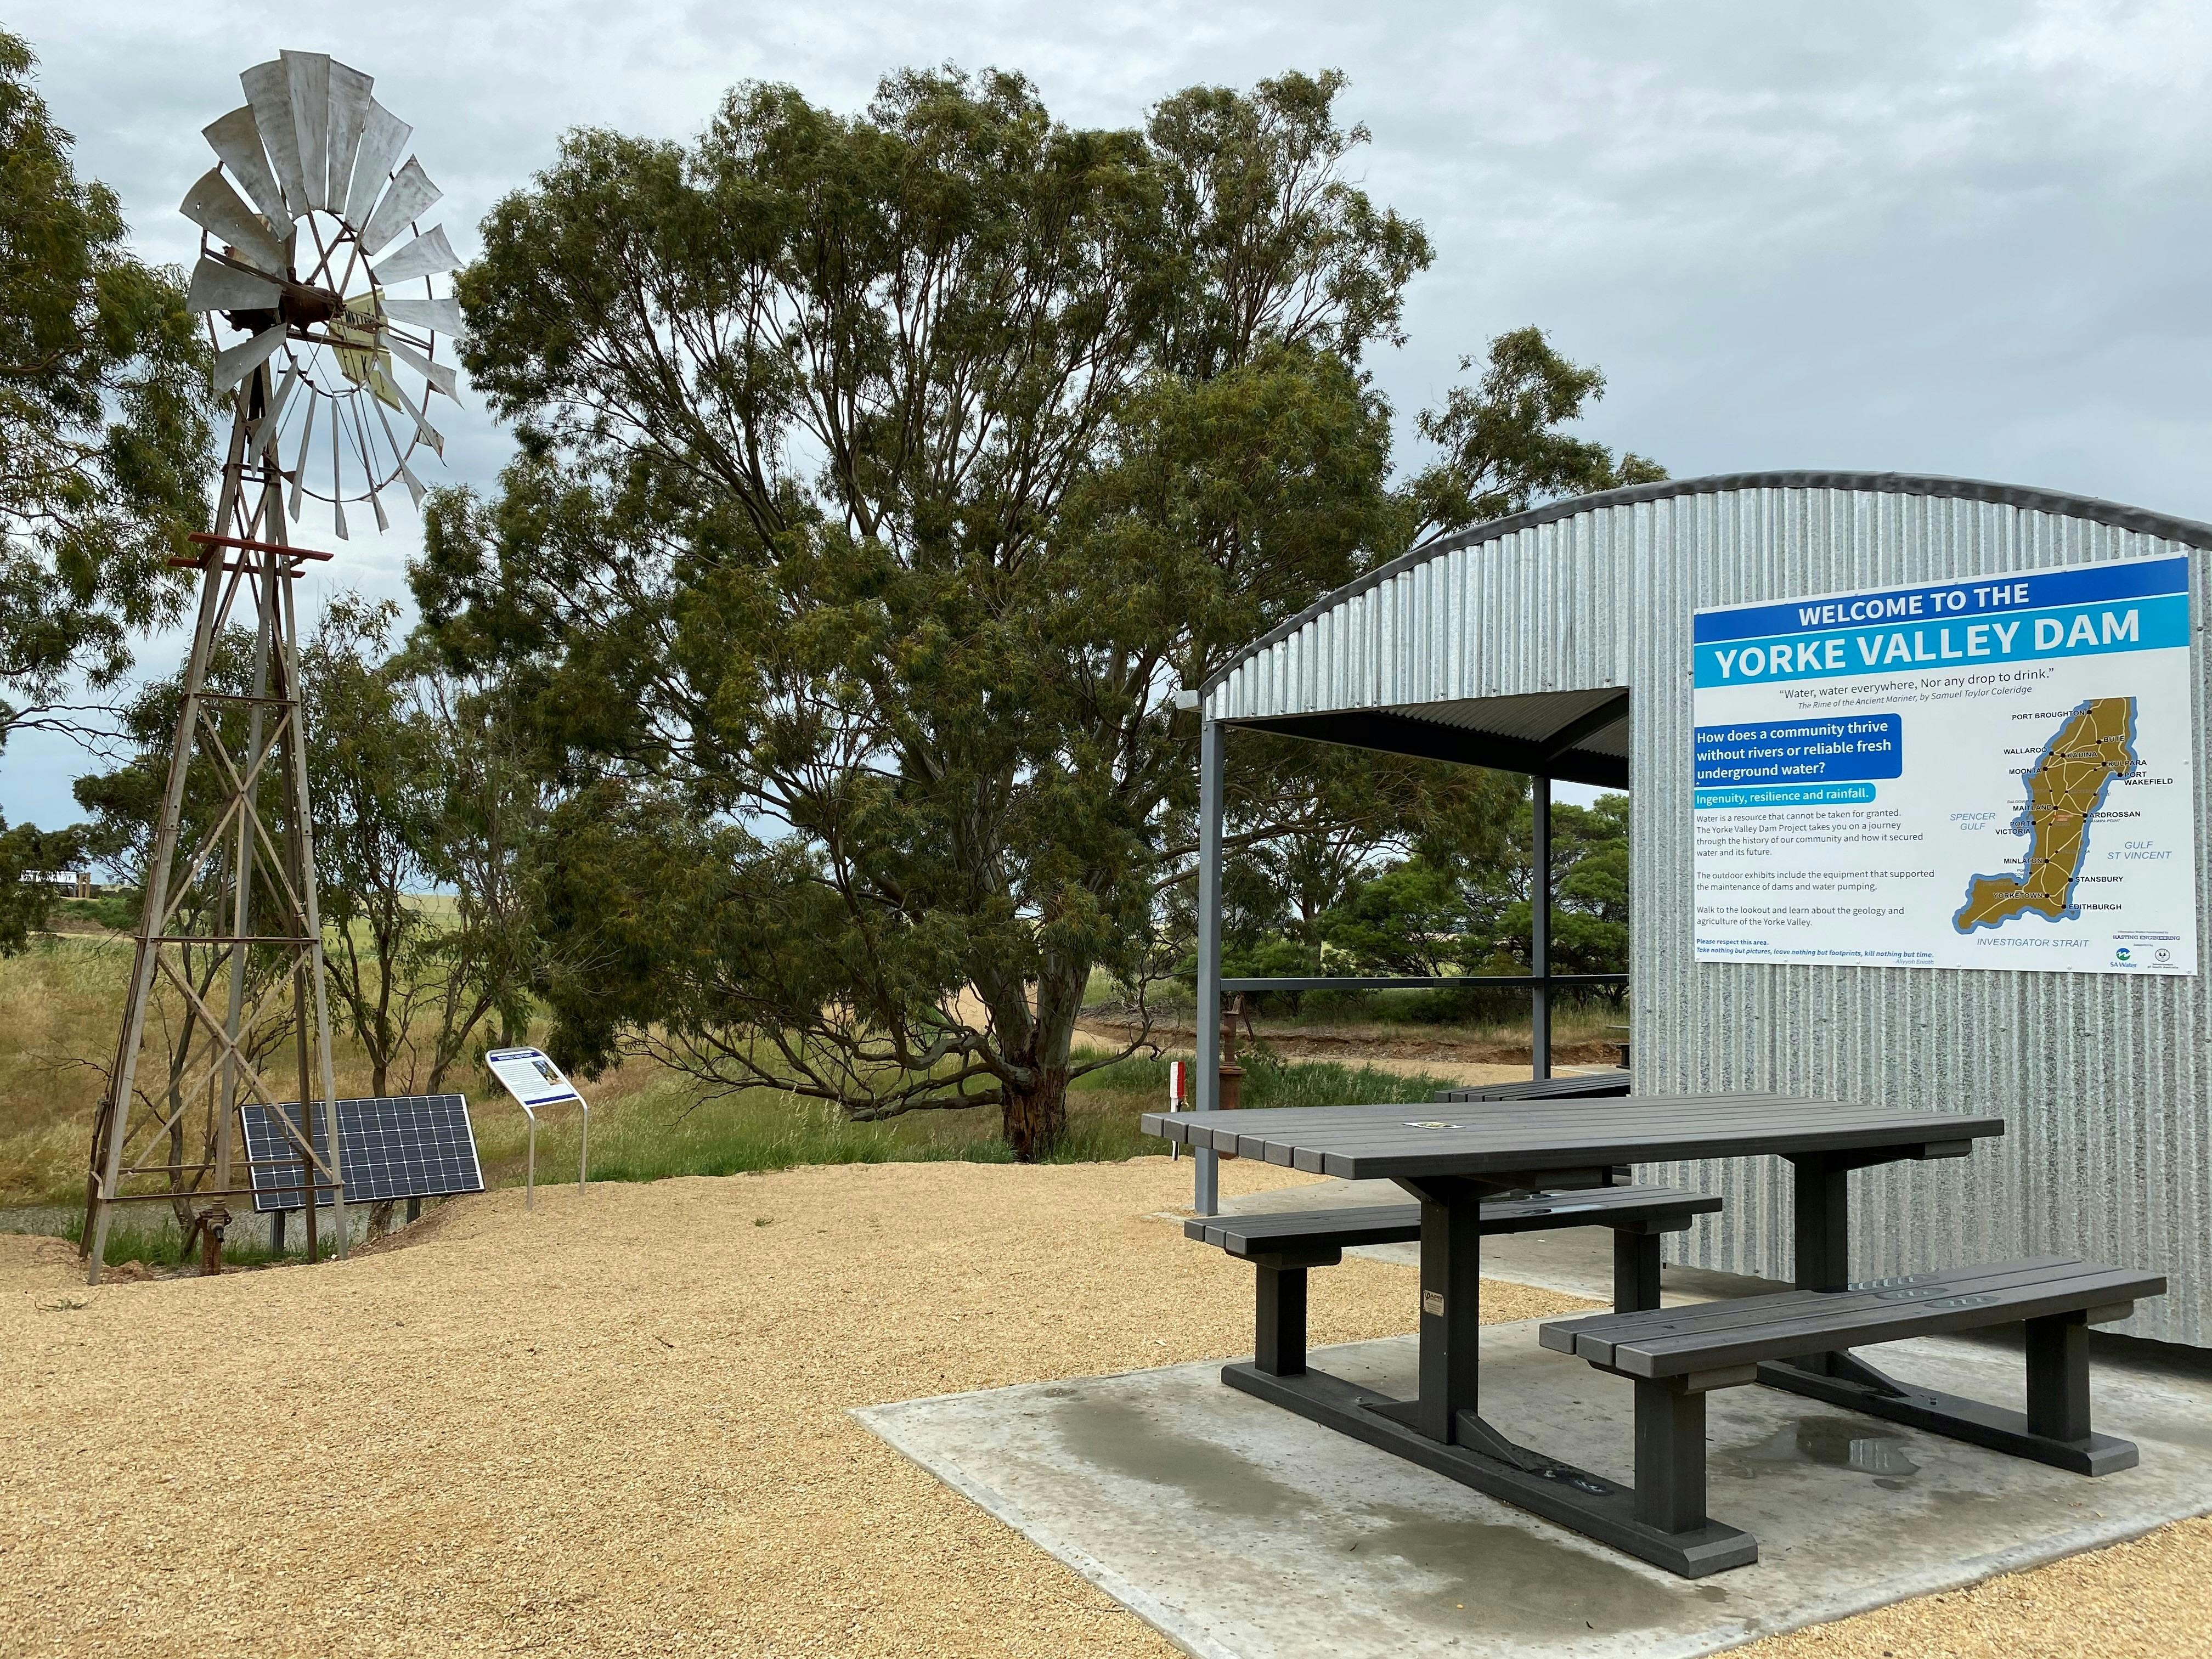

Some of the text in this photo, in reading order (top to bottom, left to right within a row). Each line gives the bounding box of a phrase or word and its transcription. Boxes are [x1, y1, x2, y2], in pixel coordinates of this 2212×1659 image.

[1798, 583, 2029, 626] WELCOME TO THE
[1714, 609, 2138, 678] YORKE VALLEY DAM
[1819, 686, 1848, 696] water
[1851, 680, 1917, 694] everywhere,
[1921, 678, 1941, 687] Nor
[1944, 678, 1965, 687] any
[1968, 674, 1995, 685] drop
[1999, 673, 2010, 682] to
[1855, 697, 1884, 705] Ancient
[1886, 695, 1917, 703] Mariner,
[1920, 693, 1929, 702] by
[1931, 690, 1962, 699] Samuel
[1964, 689, 1989, 698] Taylor
[1991, 686, 2032, 695] Coleridge
[2035, 709, 2086, 718] BROUGHTON
[1697, 721, 1888, 743] How does a community thrive
[1696, 738, 1891, 761] without rivers or reliable fresh
[2004, 747, 2047, 755] WALLAROO
[2067, 751, 2098, 759] KADINA
[2108, 759, 2147, 768] KULPARA
[1697, 761, 1825, 779] underground water?
[2124, 777, 2174, 786] WAKEFIELD
[1696, 787, 1868, 804] Ingenuity, resilience and rainfall.
[1866, 808, 1901, 819] granted.
[1949, 812, 1996, 821] SPENCER
[1734, 825, 1757, 833] Valley
[1779, 824, 1807, 832] Project
[1868, 822, 1901, 831] journey
[1960, 822, 1987, 831] GULF
[1696, 837, 1726, 845] through
[1742, 837, 1769, 845] history
[1796, 834, 1842, 843] community
[1889, 832, 1923, 840] secured
[2124, 840, 2154, 849] GULF
[2124, 851, 2172, 859] VINCENT
[1823, 870, 1868, 879] equipment
[1889, 869, 1934, 879] supported
[1837, 882, 1877, 891] pumping.
[1853, 906, 1886, 916] geology
[1697, 917, 1737, 926] agriculture
[1786, 918, 1812, 927] Valley.
[1977, 938, 2049, 946] INVESTIGATOR
